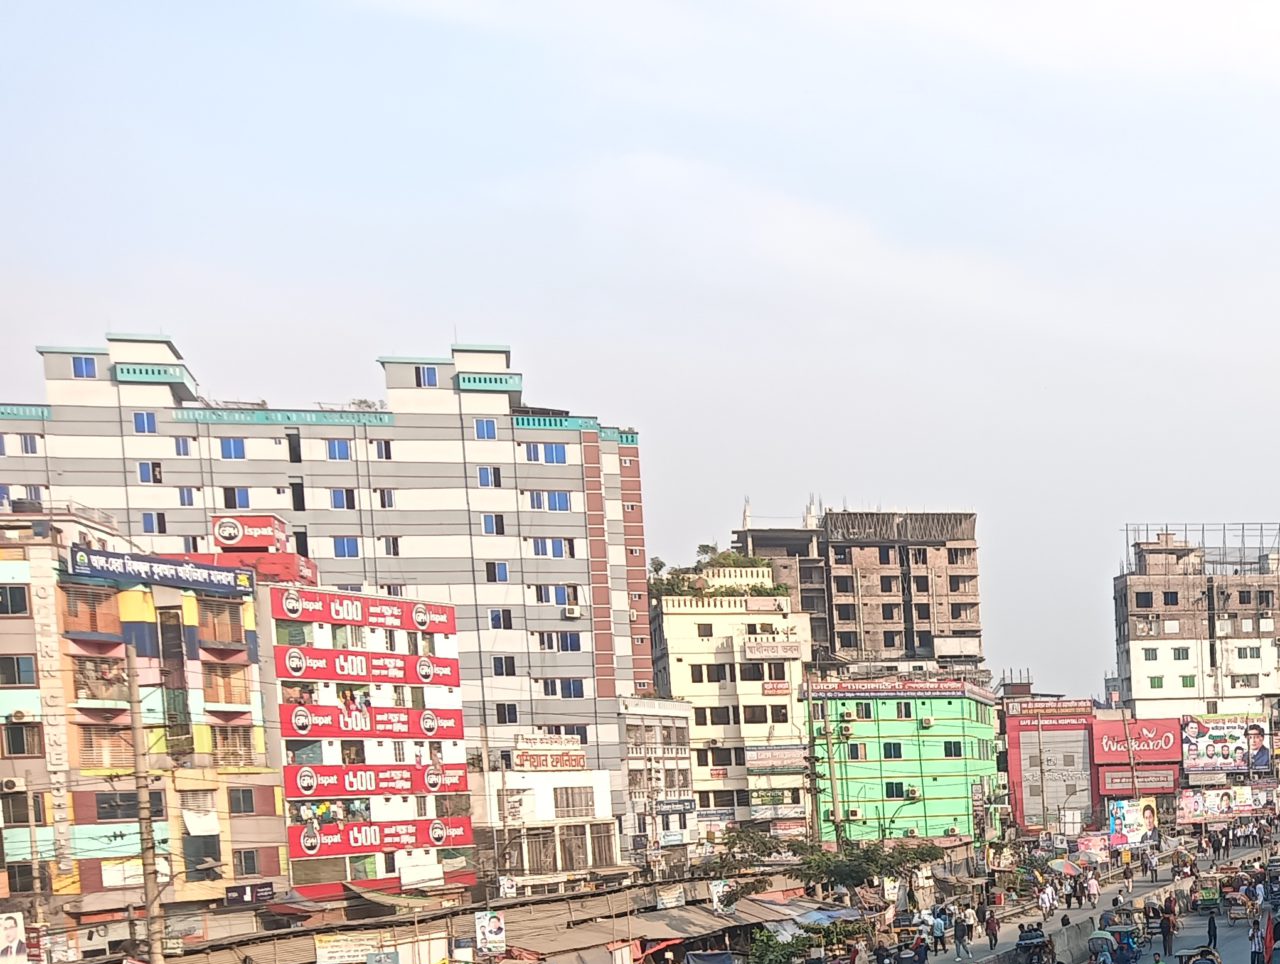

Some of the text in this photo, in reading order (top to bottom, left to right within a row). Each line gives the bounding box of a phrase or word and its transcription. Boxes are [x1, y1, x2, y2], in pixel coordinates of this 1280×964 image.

[244, 526, 273, 537] ispat
[302, 599, 322, 612] ispat
[429, 611, 447, 623] ispat
[747, 643, 799, 654] স্বাধীনতা ভবন
[306, 657, 326, 669] ispat
[433, 664, 451, 677] ispat
[311, 715, 332, 728] ispat
[437, 717, 455, 729] ispat
[515, 751, 586, 770] এশিয়ান ফার্নিচার
[318, 774, 337, 786] ispat
[442, 775, 459, 785] ispat
[447, 826, 464, 837] ispat
[321, 833, 341, 844] ispat
